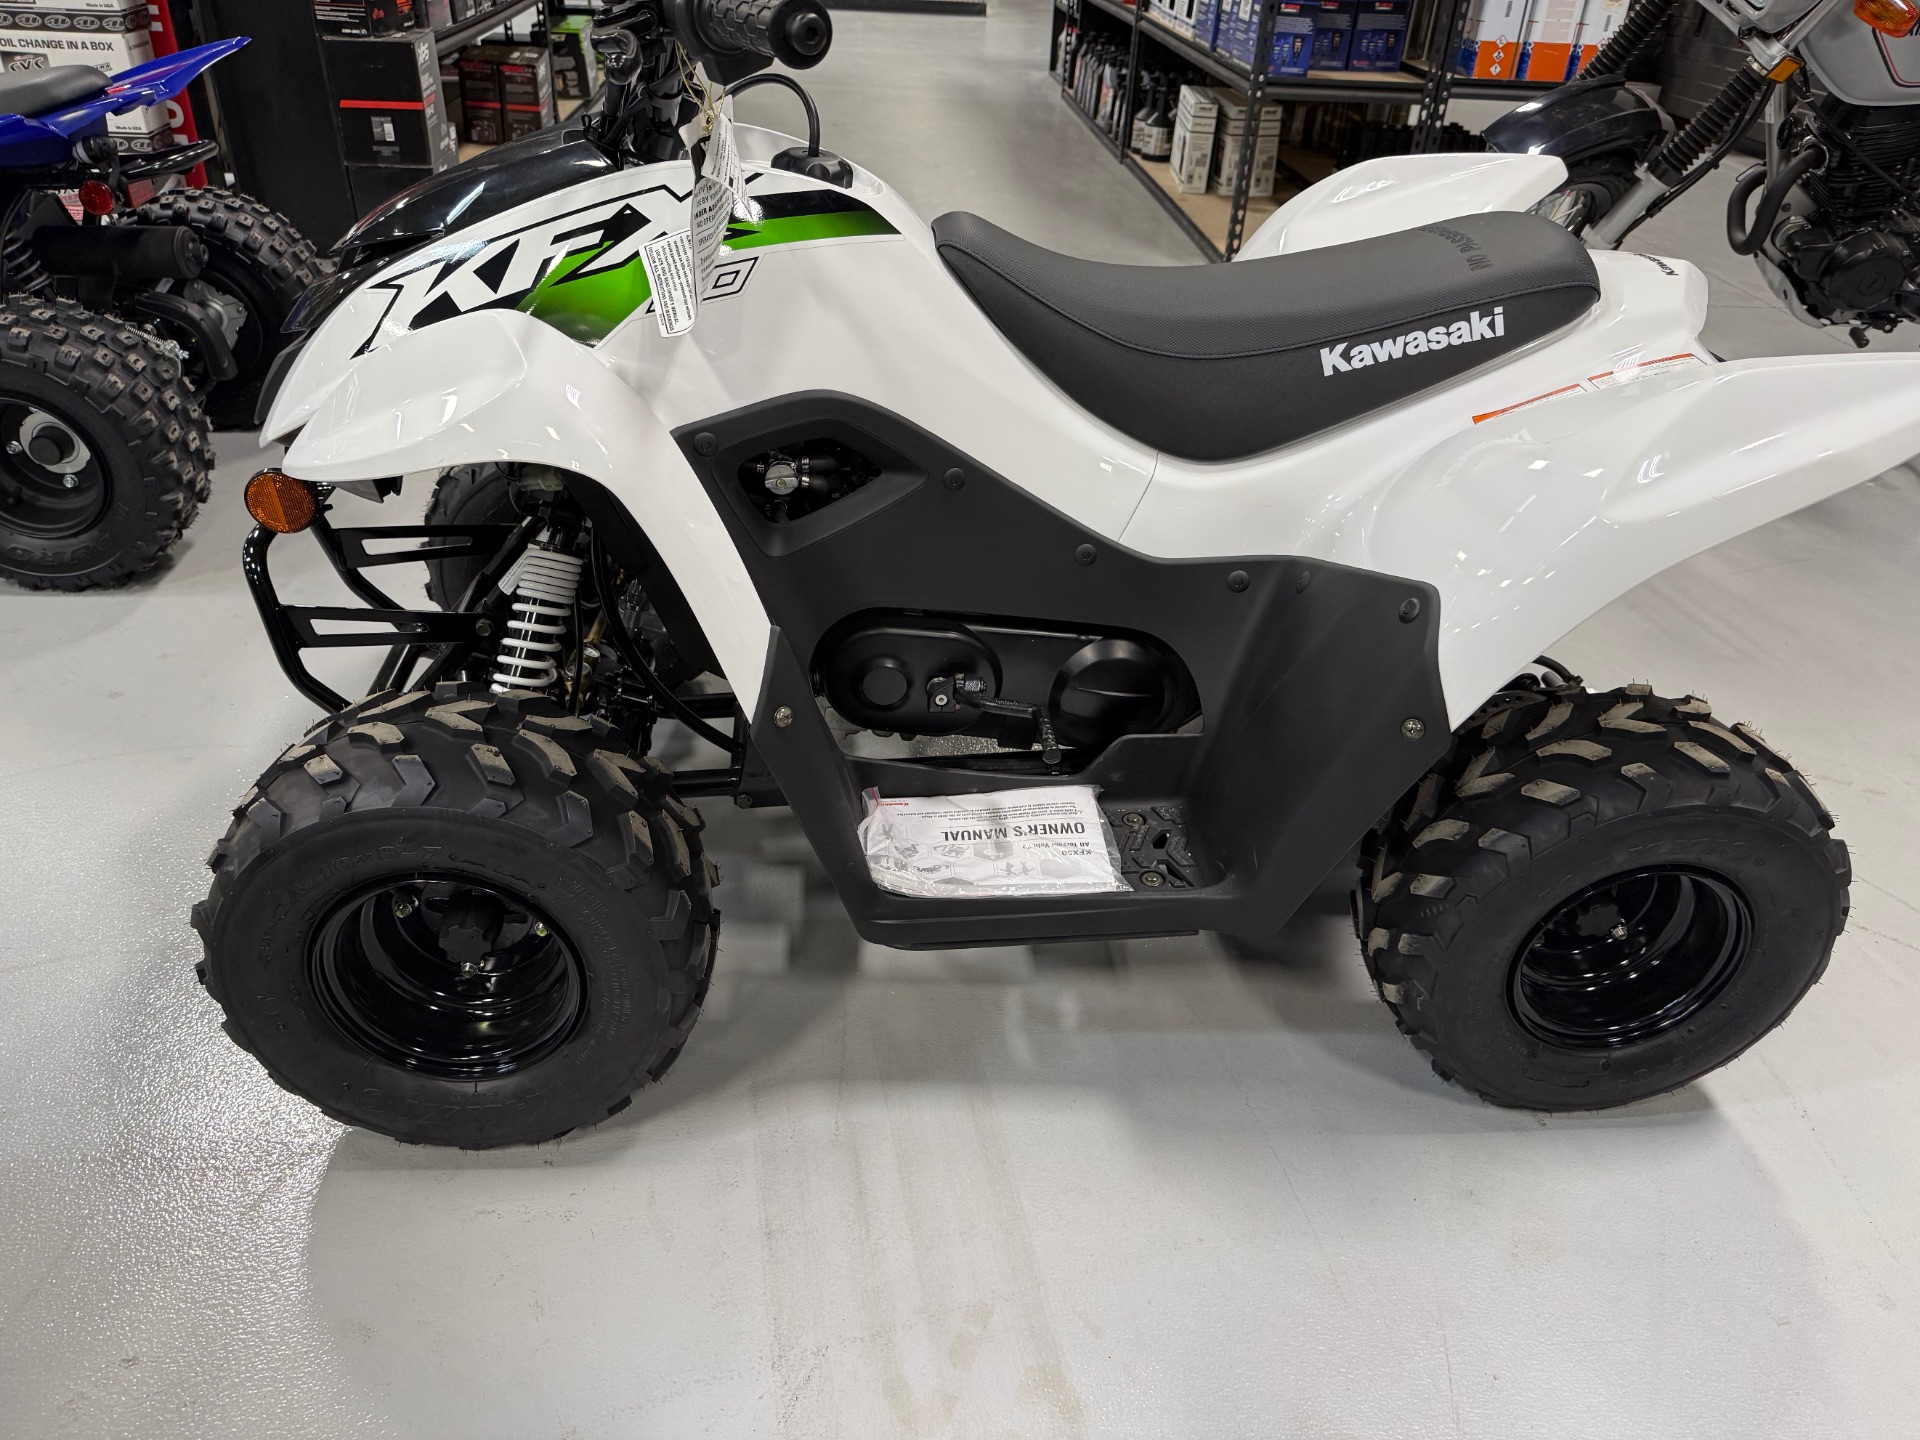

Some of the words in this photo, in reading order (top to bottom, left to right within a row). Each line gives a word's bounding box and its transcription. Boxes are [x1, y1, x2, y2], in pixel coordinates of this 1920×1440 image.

[18, 39, 66, 50] CHANGE
[67, 41, 79, 50] IN
[81, 42, 90, 51] A
[91, 42, 115, 52] BOX
[1629, 252, 1679, 277] Kawas
[1320, 306, 1505, 377] Kawasaki
[940, 826, 1007, 842] MANUAL
[1013, 822, 1085, 837] OWNER'S
